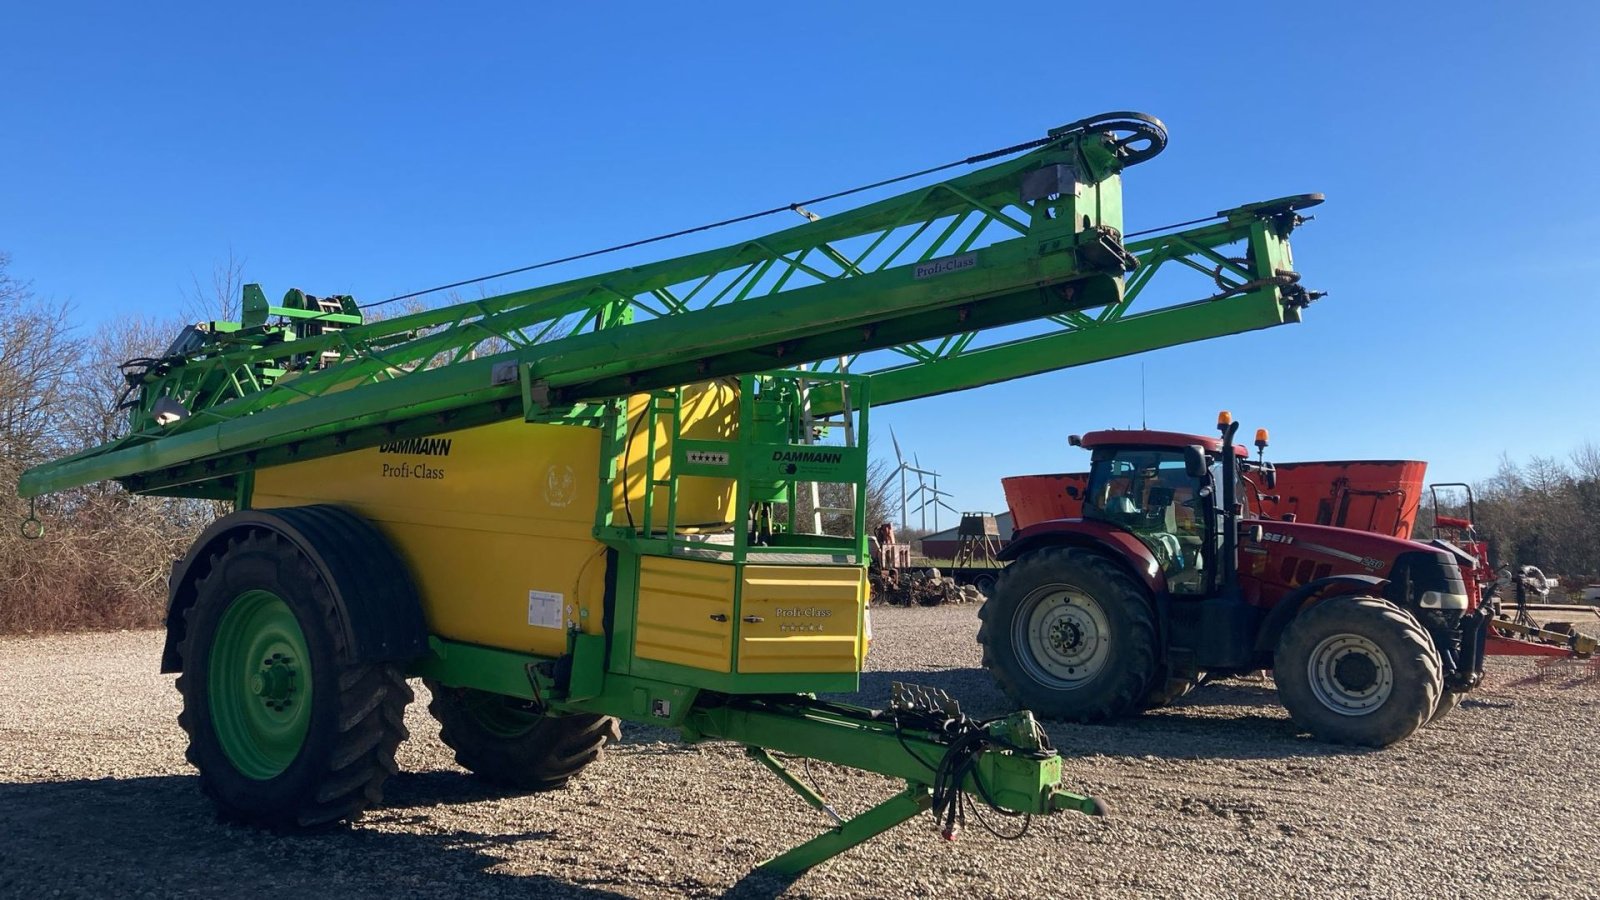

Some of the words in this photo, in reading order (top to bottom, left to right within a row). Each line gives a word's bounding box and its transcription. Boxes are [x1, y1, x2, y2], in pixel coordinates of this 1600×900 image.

[917, 258, 974, 277] Profi-Class
[379, 438, 452, 456] DAMMANN
[772, 451, 842, 464] DAMMANN
[382, 462, 445, 480] Profi-Class
[776, 607, 832, 618] Profi-Class
